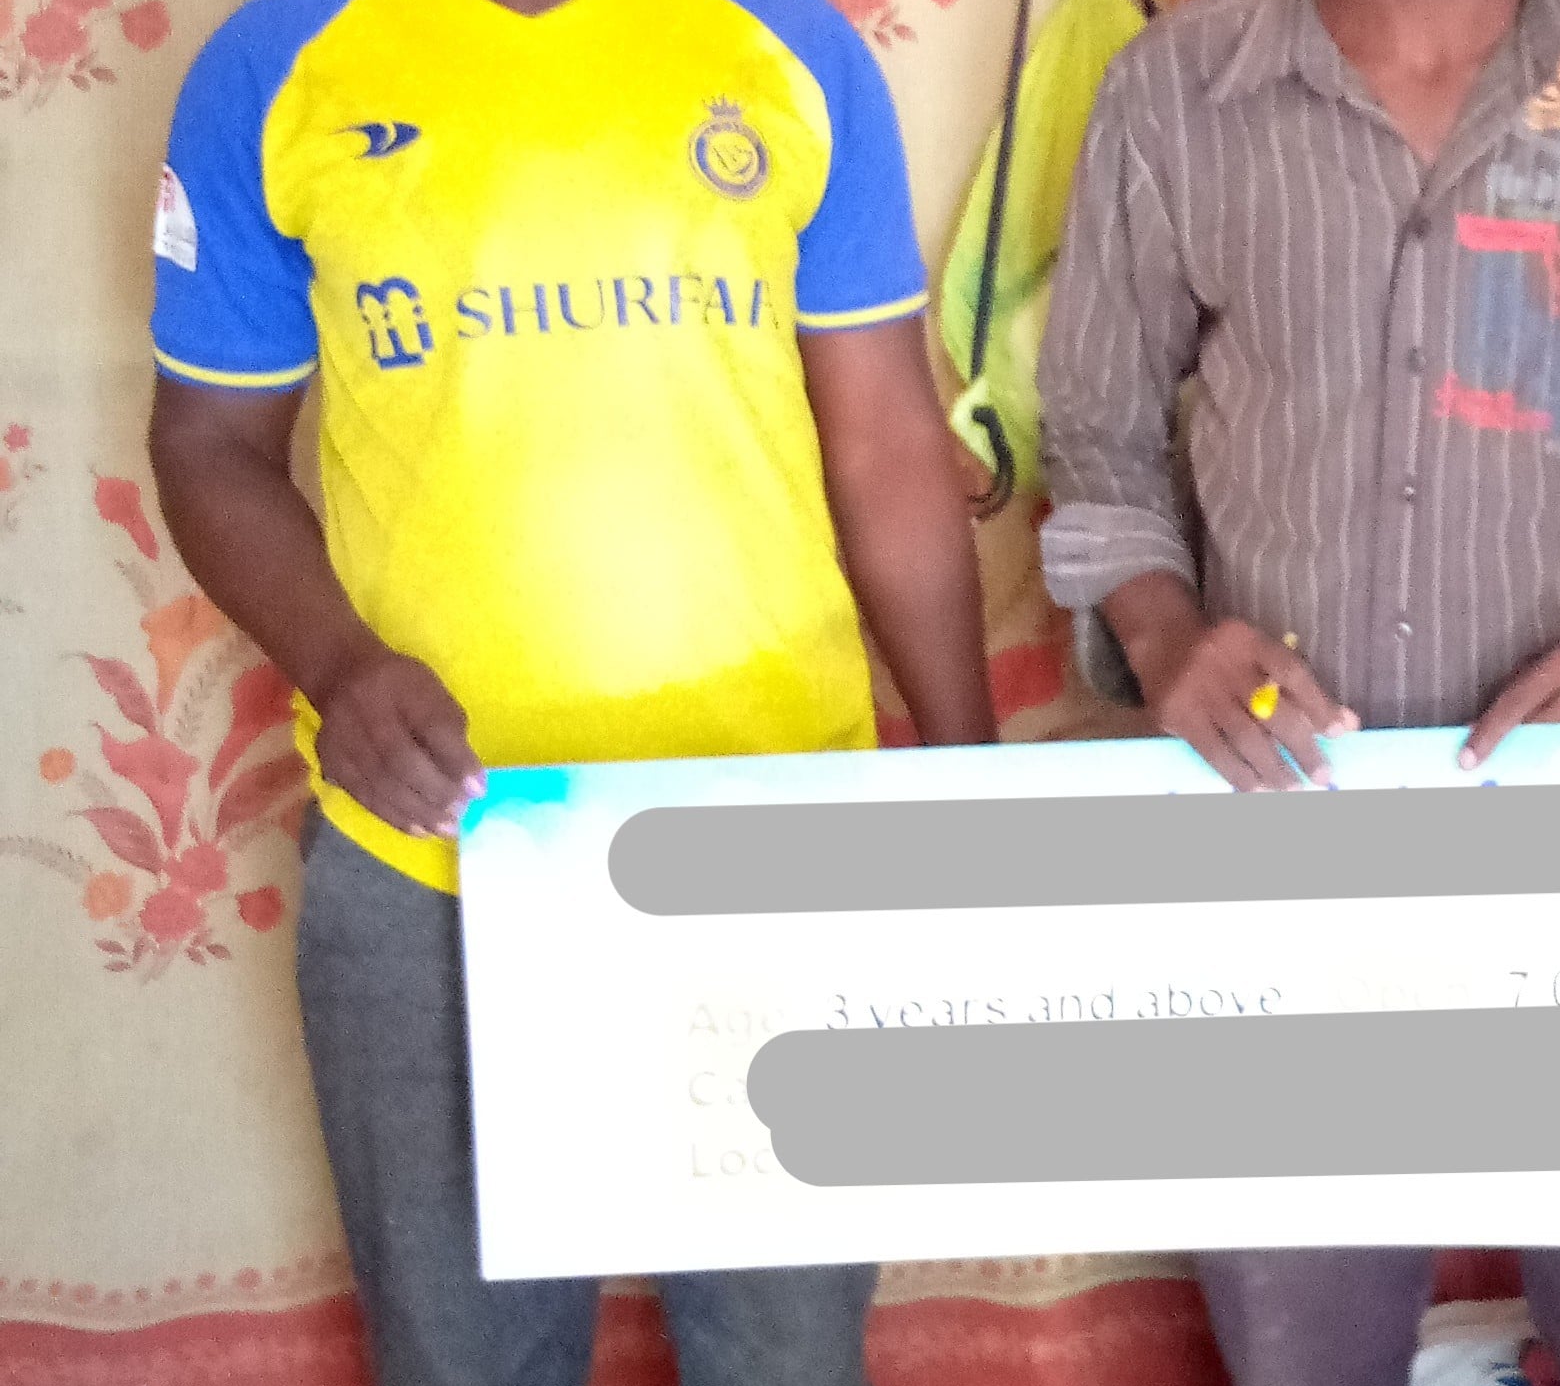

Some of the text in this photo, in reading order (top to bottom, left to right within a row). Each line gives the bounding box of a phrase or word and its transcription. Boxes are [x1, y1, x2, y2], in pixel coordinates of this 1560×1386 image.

[826, 994, 849, 1030] 3
[869, 997, 1007, 1029] years
[1027, 986, 1116, 1023] and
[1136, 982, 1282, 1019] above
